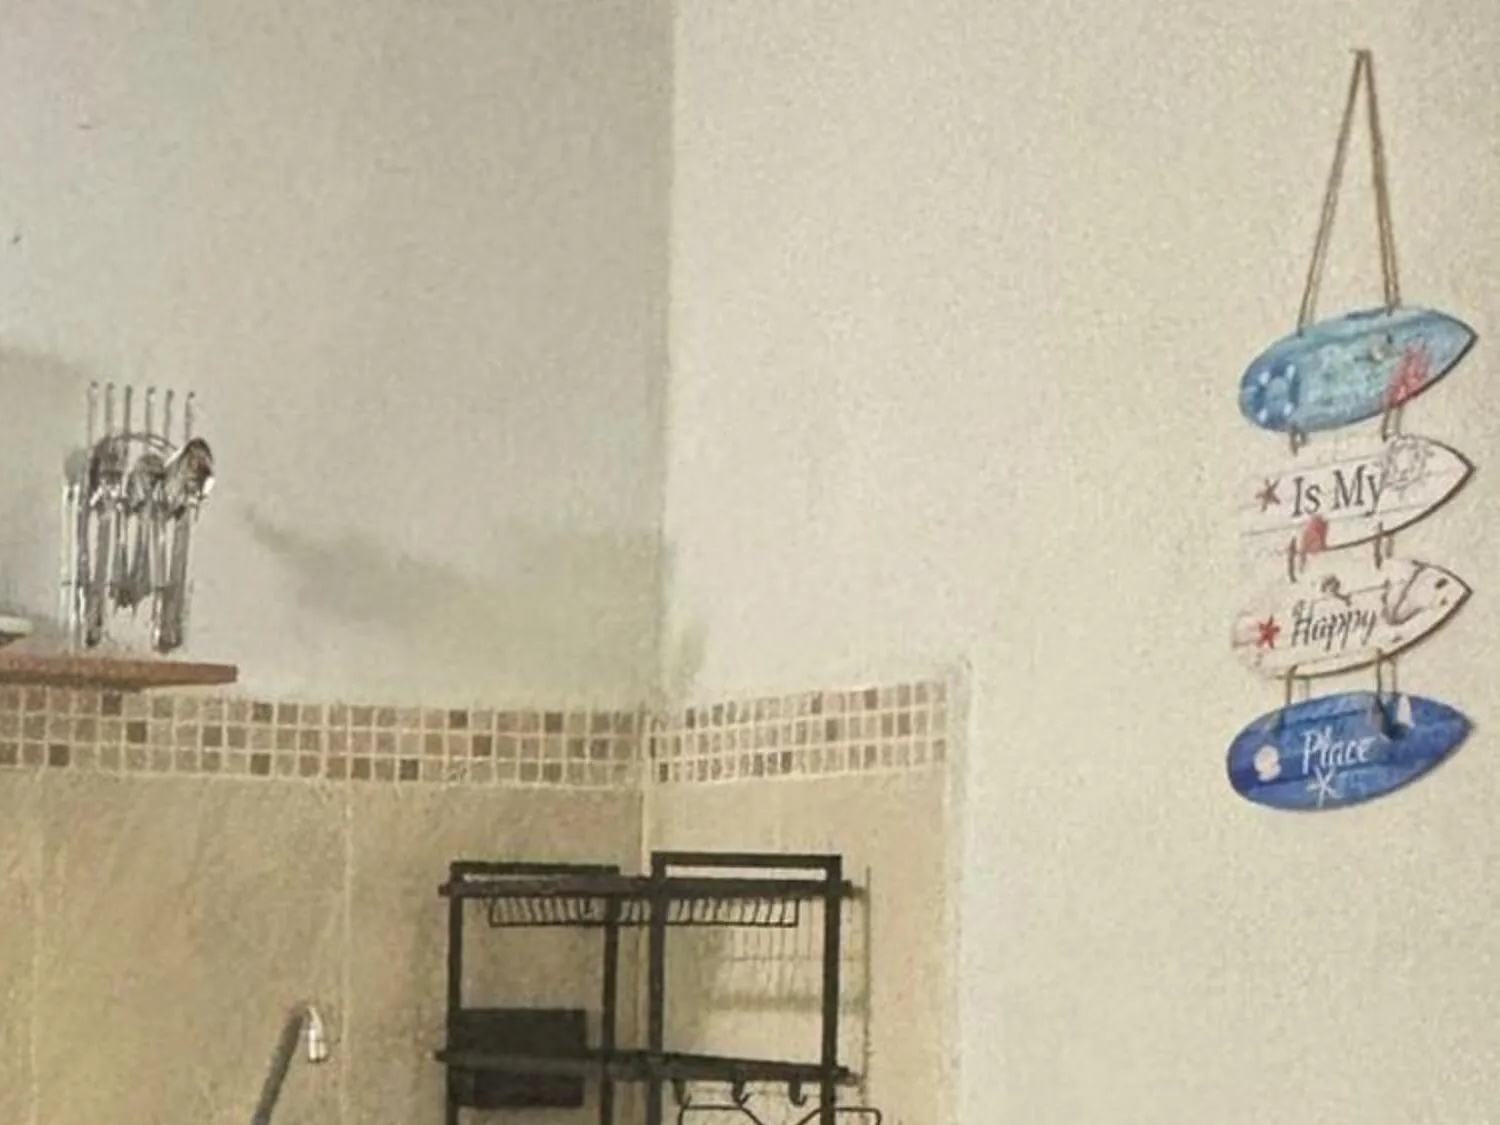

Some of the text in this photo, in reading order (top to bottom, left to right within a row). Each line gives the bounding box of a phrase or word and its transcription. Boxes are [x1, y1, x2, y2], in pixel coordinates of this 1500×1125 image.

[1292, 465, 1384, 516] Is My
[1291, 600, 1377, 650] Happy
[1302, 725, 1374, 775] Place
